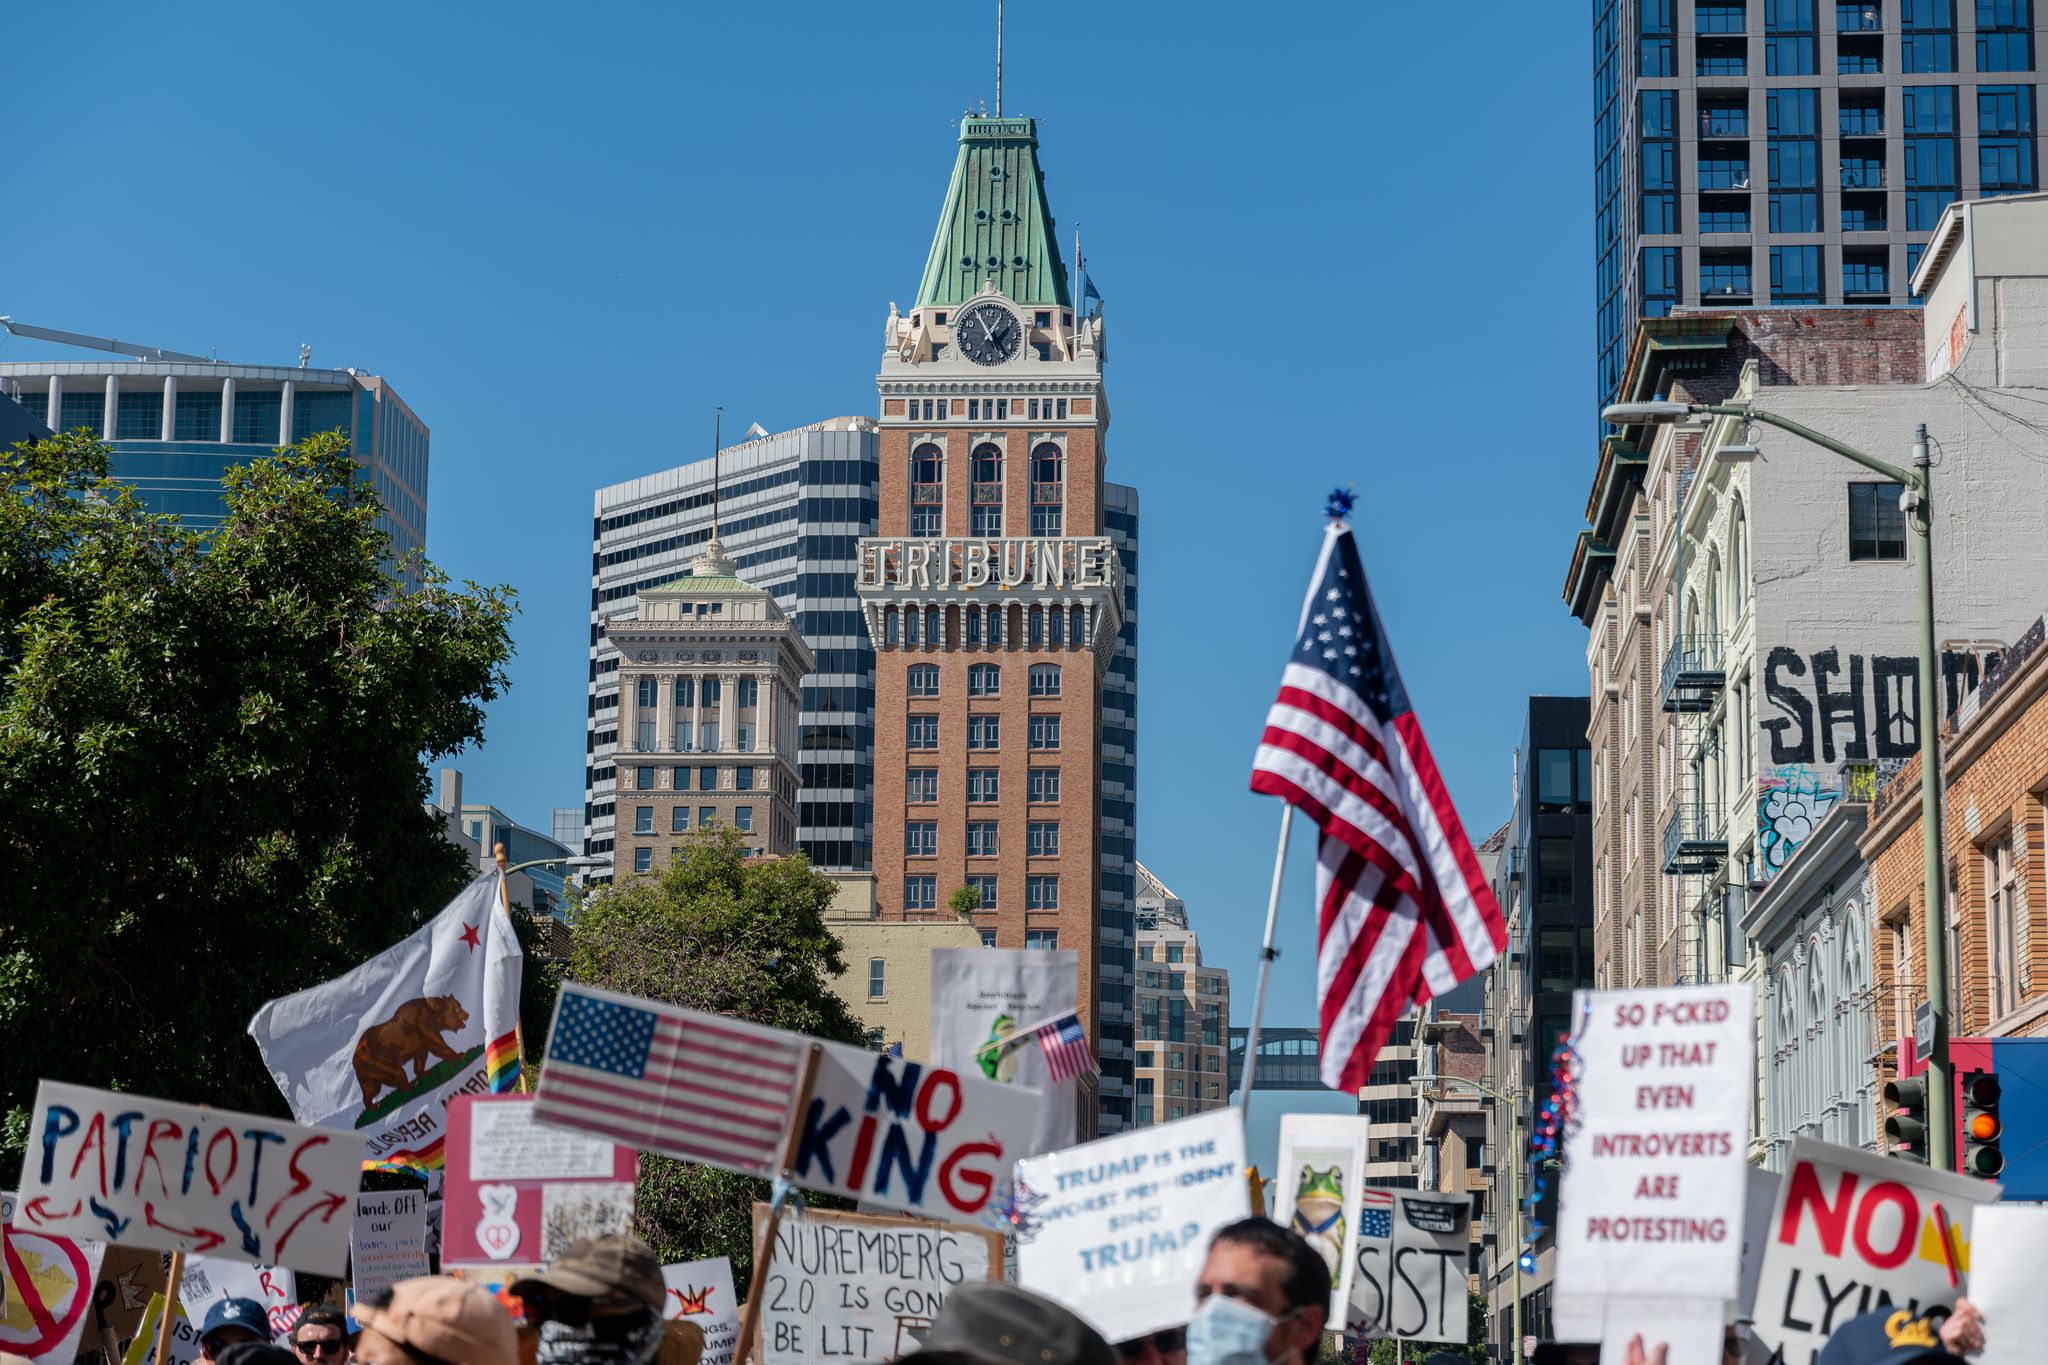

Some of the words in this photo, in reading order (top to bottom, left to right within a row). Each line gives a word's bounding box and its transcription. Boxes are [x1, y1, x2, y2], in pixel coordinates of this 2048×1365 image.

[868, 538, 1111, 590] TRIBUNE
[1614, 1003, 1645, 1028] SO
[1622, 1043, 1651, 1069] UP
[1659, 1041, 1717, 1068] THAT
[865, 1054, 963, 1133] NO
[1636, 1085, 1695, 1109] EVEN
[795, 1096, 1003, 1215] KING
[1592, 1132, 1732, 1158] INTROVERTS
[40, 1105, 330, 1229] PATRIOTS
[1055, 1155, 1148, 1192] TRUMP
[1154, 1152, 1172, 1167] IS
[1179, 1140, 1216, 1160] THE
[1125, 1162, 1235, 1202] PREIDENT
[1635, 1176, 1680, 1200] ARE
[1586, 1217, 1728, 1243] PROTESTING
[1778, 1160, 1920, 1270] NO
[770, 1224, 964, 1284] NUREMBERG
[1079, 1220, 1200, 1274] TRUMP
[769, 1275, 814, 1315] 2.0
[839, 1283, 869, 1309] IS
[885, 1286, 946, 1317] GON
[1356, 1247, 1466, 1337] SIST
[703, 1323, 732, 1335] NGS.
[704, 1336, 737, 1350] UMP
[775, 1321, 804, 1353] BE
[821, 1325, 874, 1360] LIT
